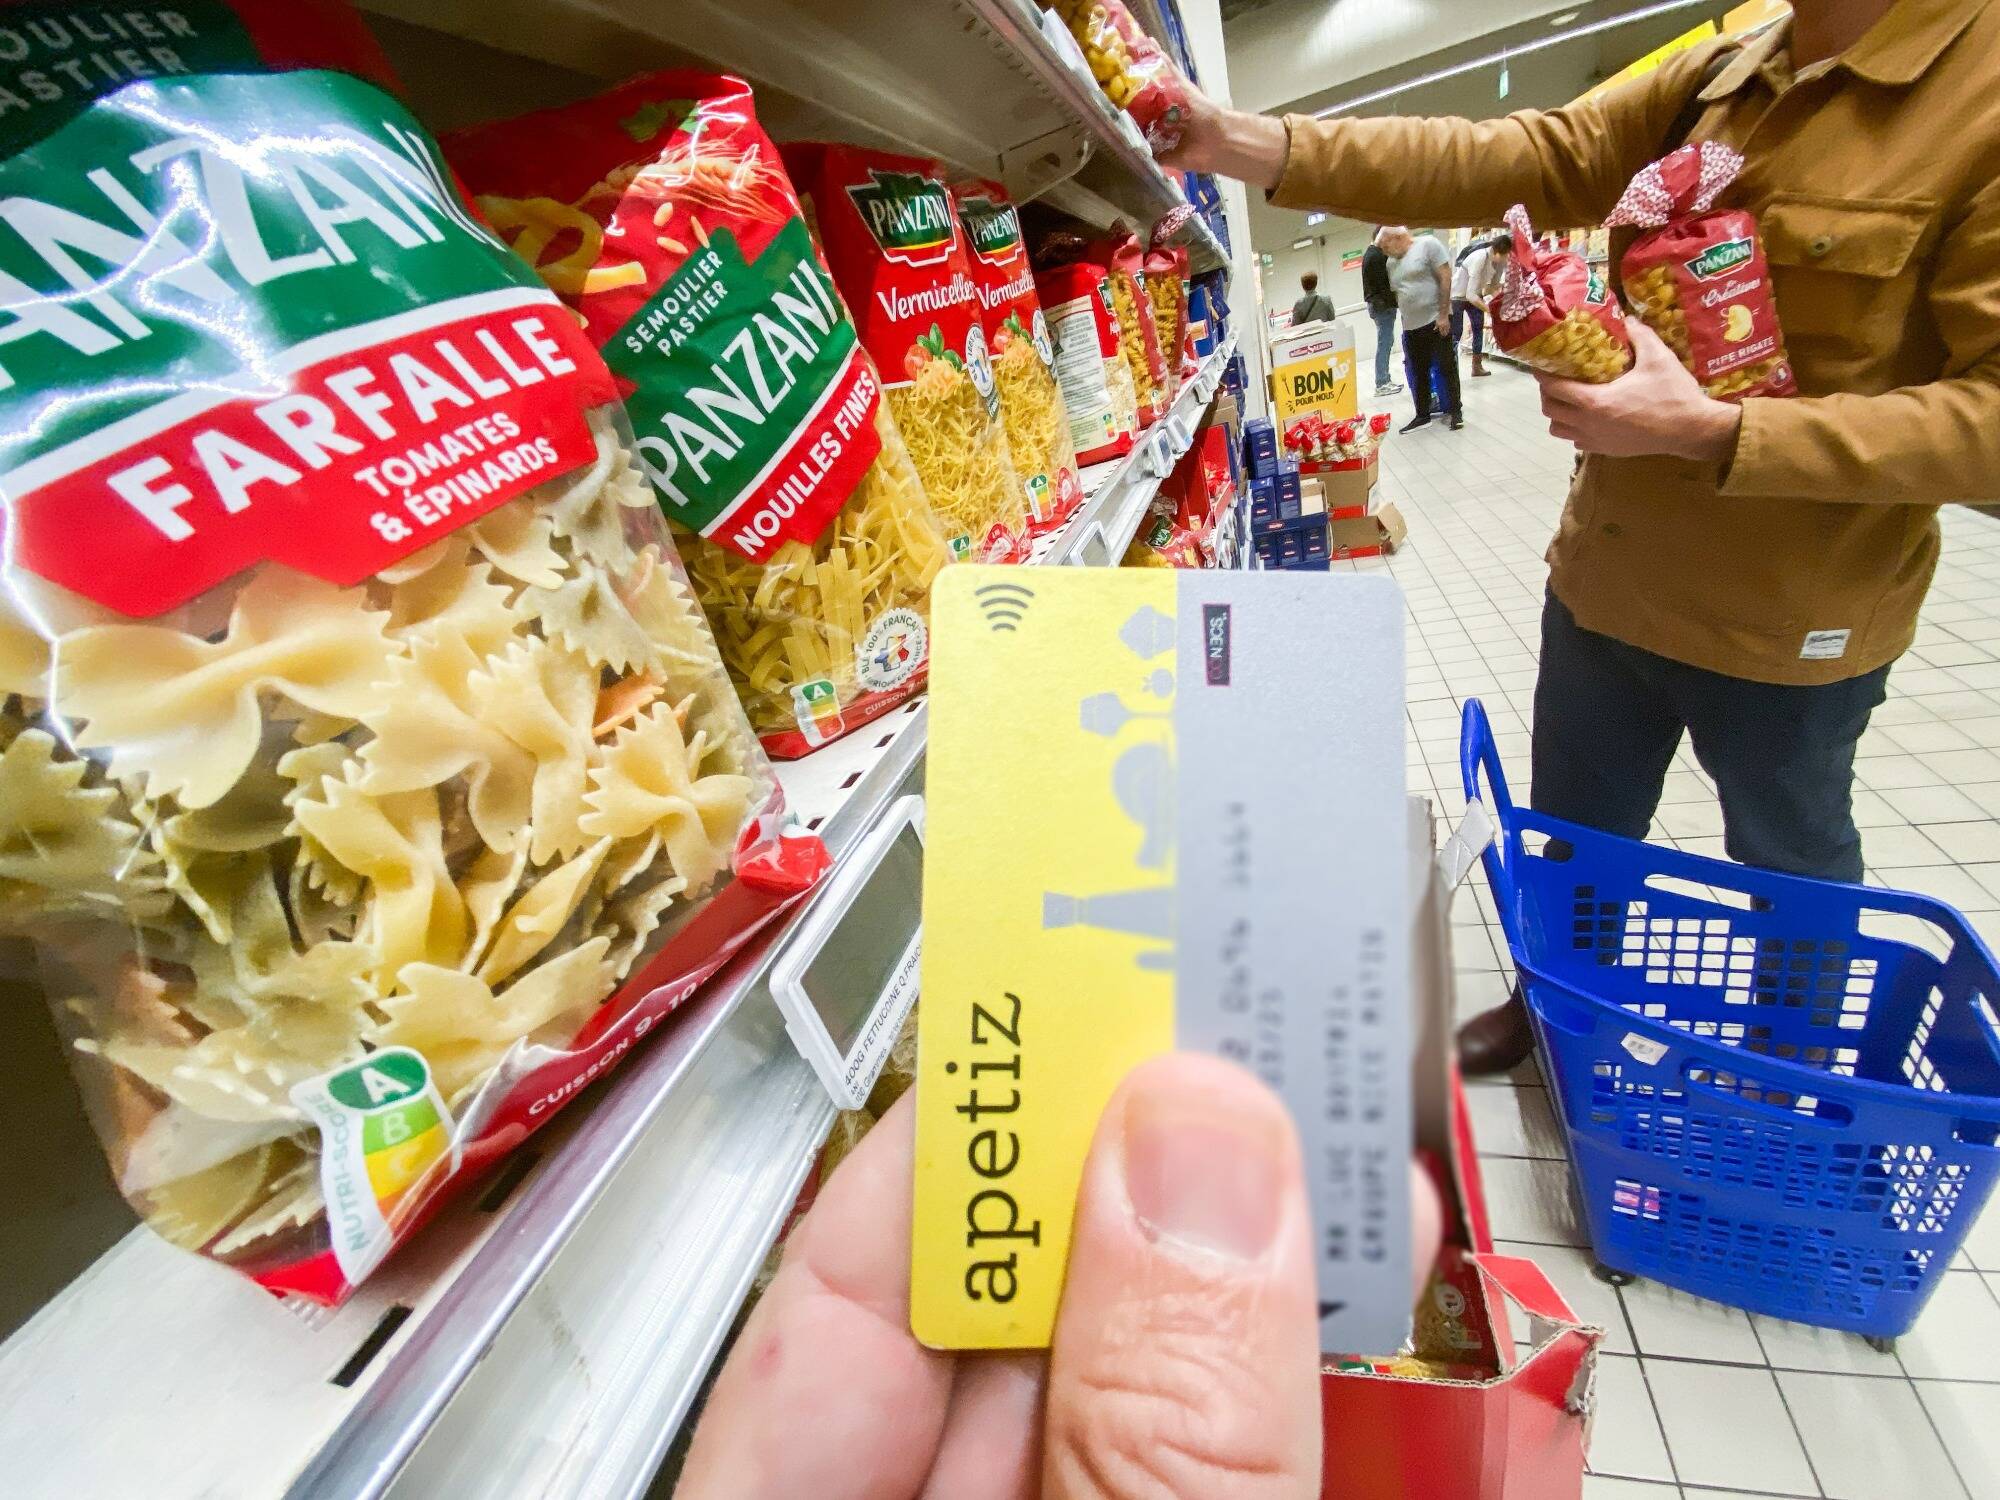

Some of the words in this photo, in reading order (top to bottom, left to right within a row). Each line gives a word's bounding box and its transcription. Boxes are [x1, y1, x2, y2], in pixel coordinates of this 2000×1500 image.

[868, 195, 950, 237] PANZANI
[969, 209, 1018, 245] PANZANI
[1695, 243, 1751, 275] PANZANI
[626, 250, 724, 353] SEMOULIER
[656, 280, 728, 356] PASTIER
[876, 273, 976, 322] Vermicelles
[1706, 350, 1737, 369] PIPE
[1738, 336, 1775, 358] RIGATE
[633, 259, 838, 507] PANZANI
[1294, 367, 1333, 396] BON
[1295, 395, 1315, 407] POUR
[1316, 391, 1335, 403] NOUS
[106, 317, 577, 542] FARFALLE
[354, 412, 520, 497] TOMATES
[733, 431, 842, 555] NOUILLES
[833, 371, 876, 440] FINES
[370, 511, 413, 542] &
[403, 438, 558, 526] ÉPINARDS
[812, 685, 827, 699] A
[361, 1067, 411, 1103] A
[529, 1038, 628, 1115] CUISSON
[844, 1050, 865, 1087] 400G
[383, 1111, 411, 1145] B
[946, 991, 1040, 1304] apetiz
[305, 1093, 371, 1251] NUTRI-SCORE
